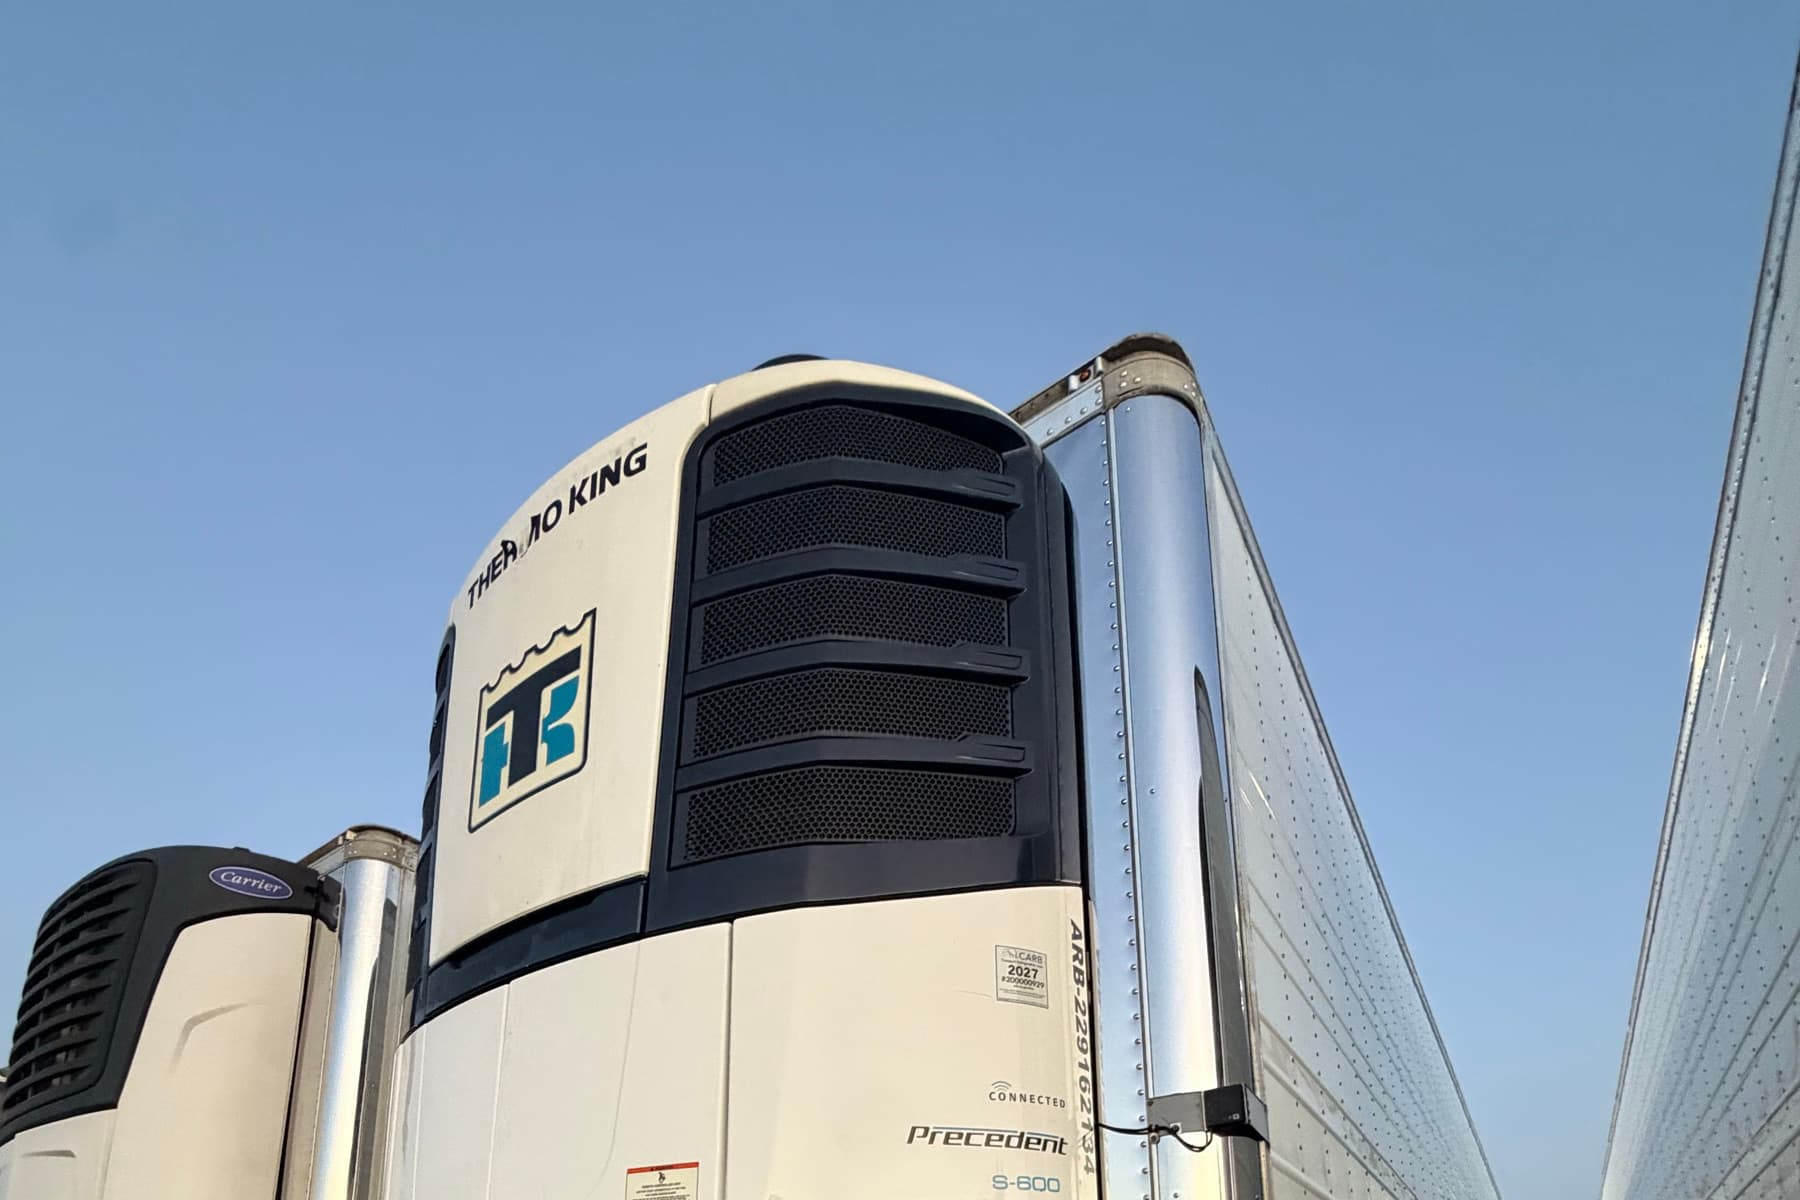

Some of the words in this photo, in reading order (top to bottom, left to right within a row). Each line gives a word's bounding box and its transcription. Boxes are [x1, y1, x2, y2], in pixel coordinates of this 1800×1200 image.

[568, 442, 648, 515] KING
[220, 871, 283, 893] Carrier
[1007, 964, 1039, 979] 2027
[988, 1091, 1066, 1108] CONNECTED
[906, 1125, 1068, 1156] Precedent
[992, 1175, 1061, 1193] S-600
